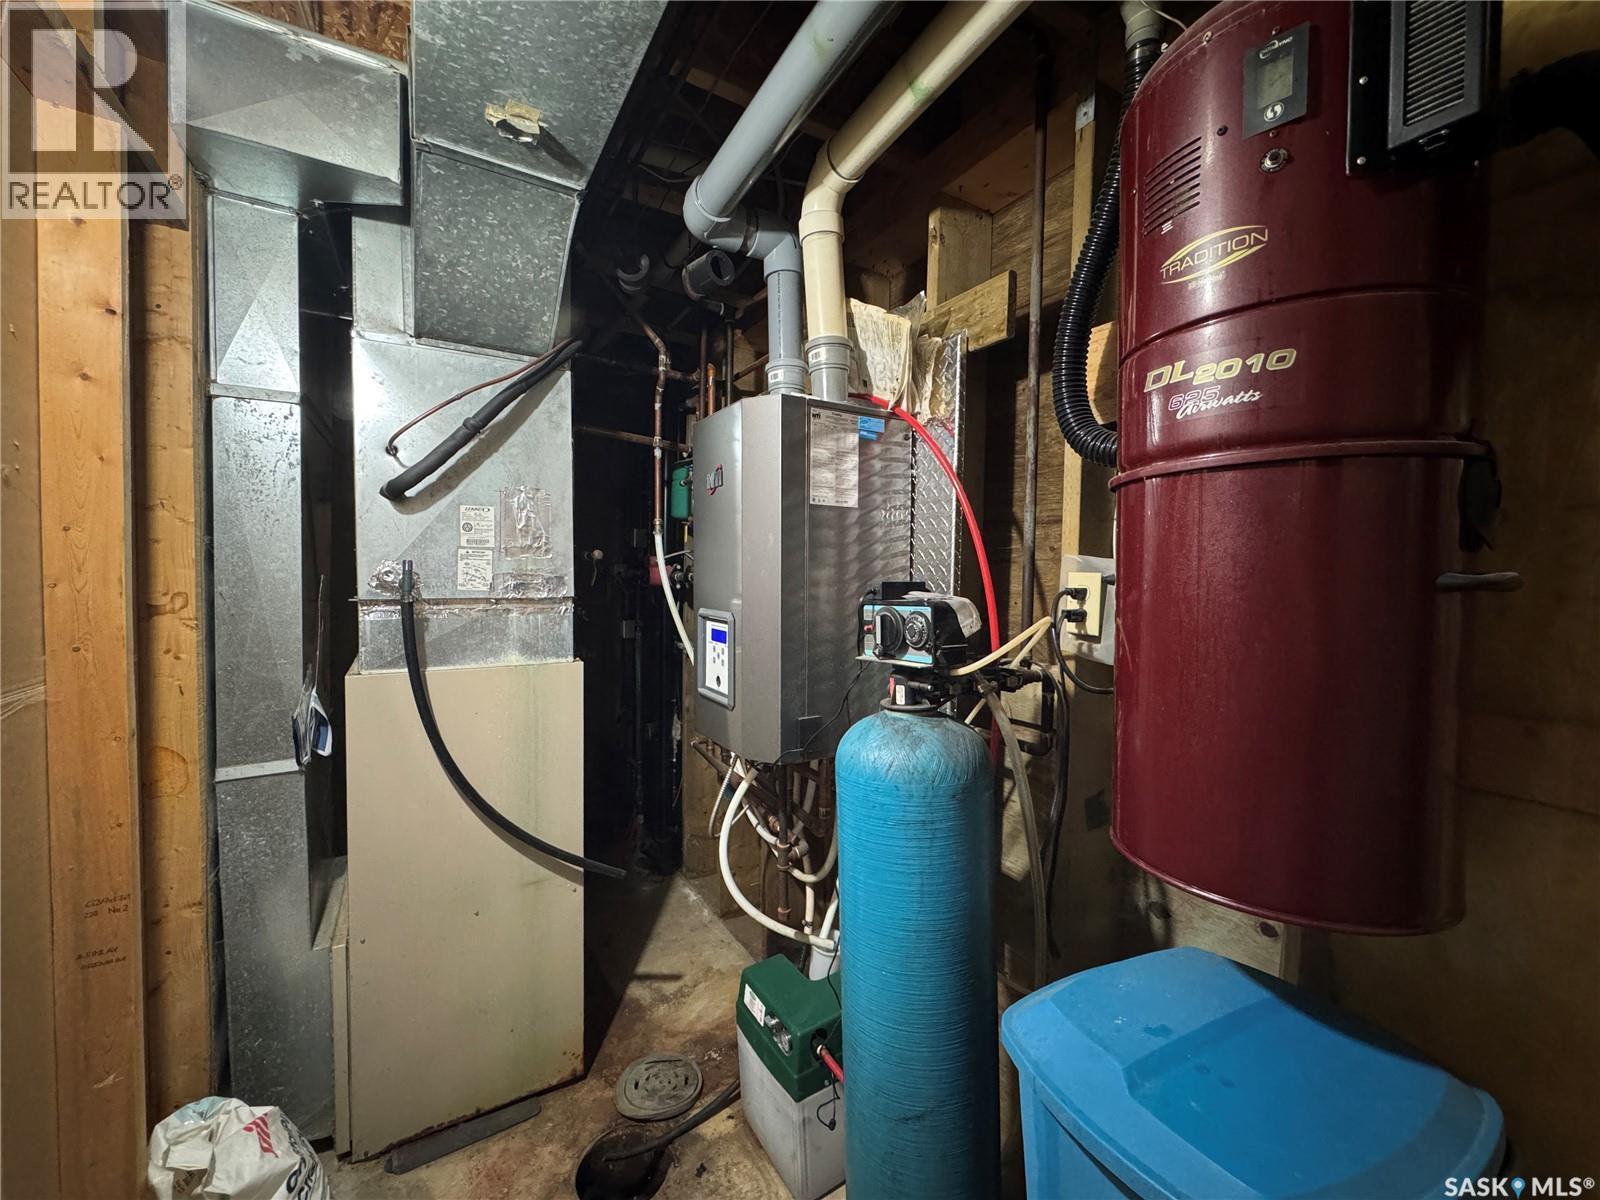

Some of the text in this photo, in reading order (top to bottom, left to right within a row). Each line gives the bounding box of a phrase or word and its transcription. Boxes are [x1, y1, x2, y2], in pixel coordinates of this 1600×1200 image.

[1160, 229, 1269, 280] TRADITION
[1144, 348, 1297, 393] DL2010
[1168, 385, 1220, 411] 625
